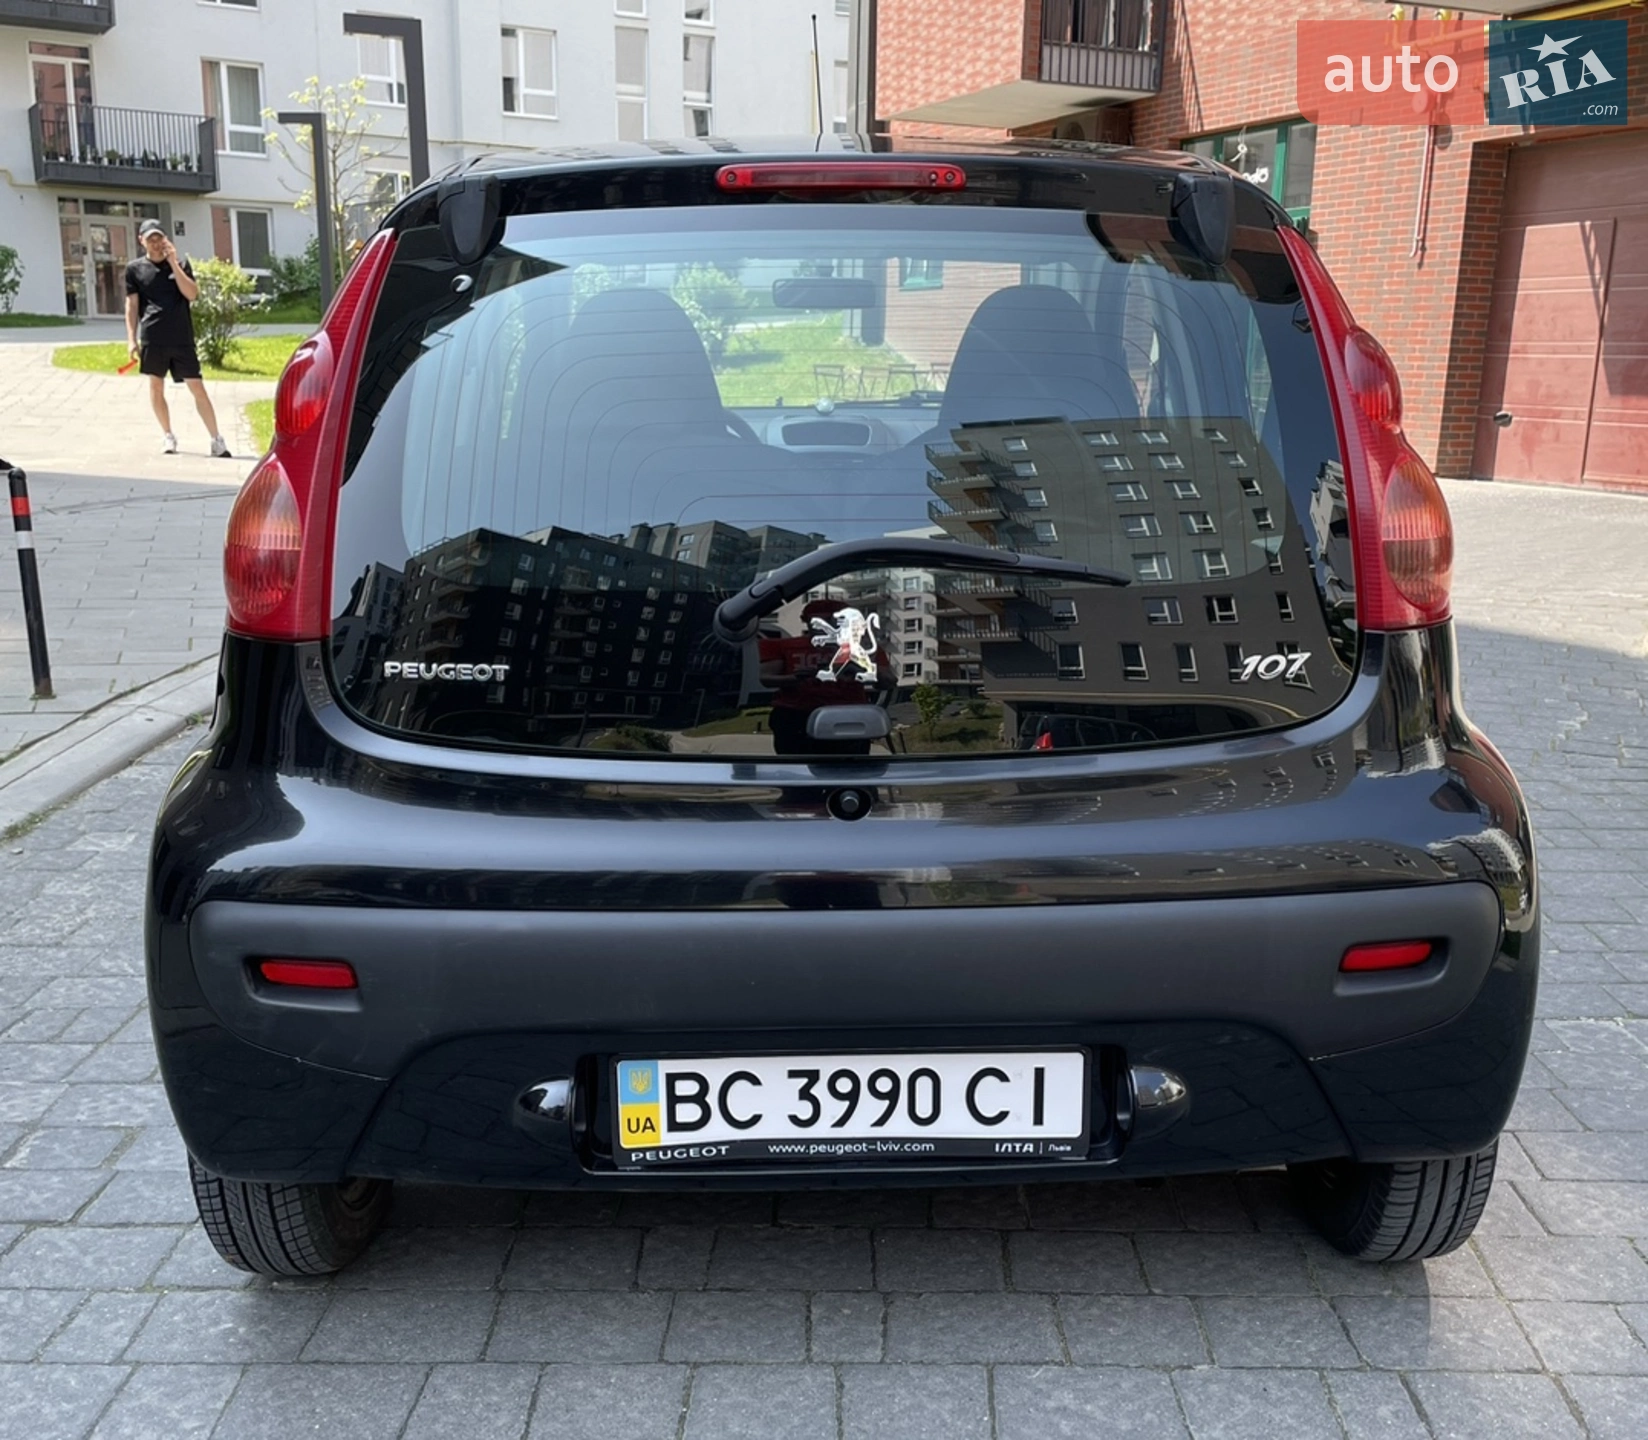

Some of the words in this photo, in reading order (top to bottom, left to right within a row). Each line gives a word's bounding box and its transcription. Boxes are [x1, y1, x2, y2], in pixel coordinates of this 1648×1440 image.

[383, 660, 510, 682] PEUGEOT
[1240, 651, 1312, 681] 107
[664, 1070, 763, 1133] BC
[787, 1067, 942, 1129] 3990
[626, 1116, 657, 1134] UA
[630, 1145, 730, 1162] PEUGEOT
[767, 1141, 935, 1156] www.peugeot-lviv.com
